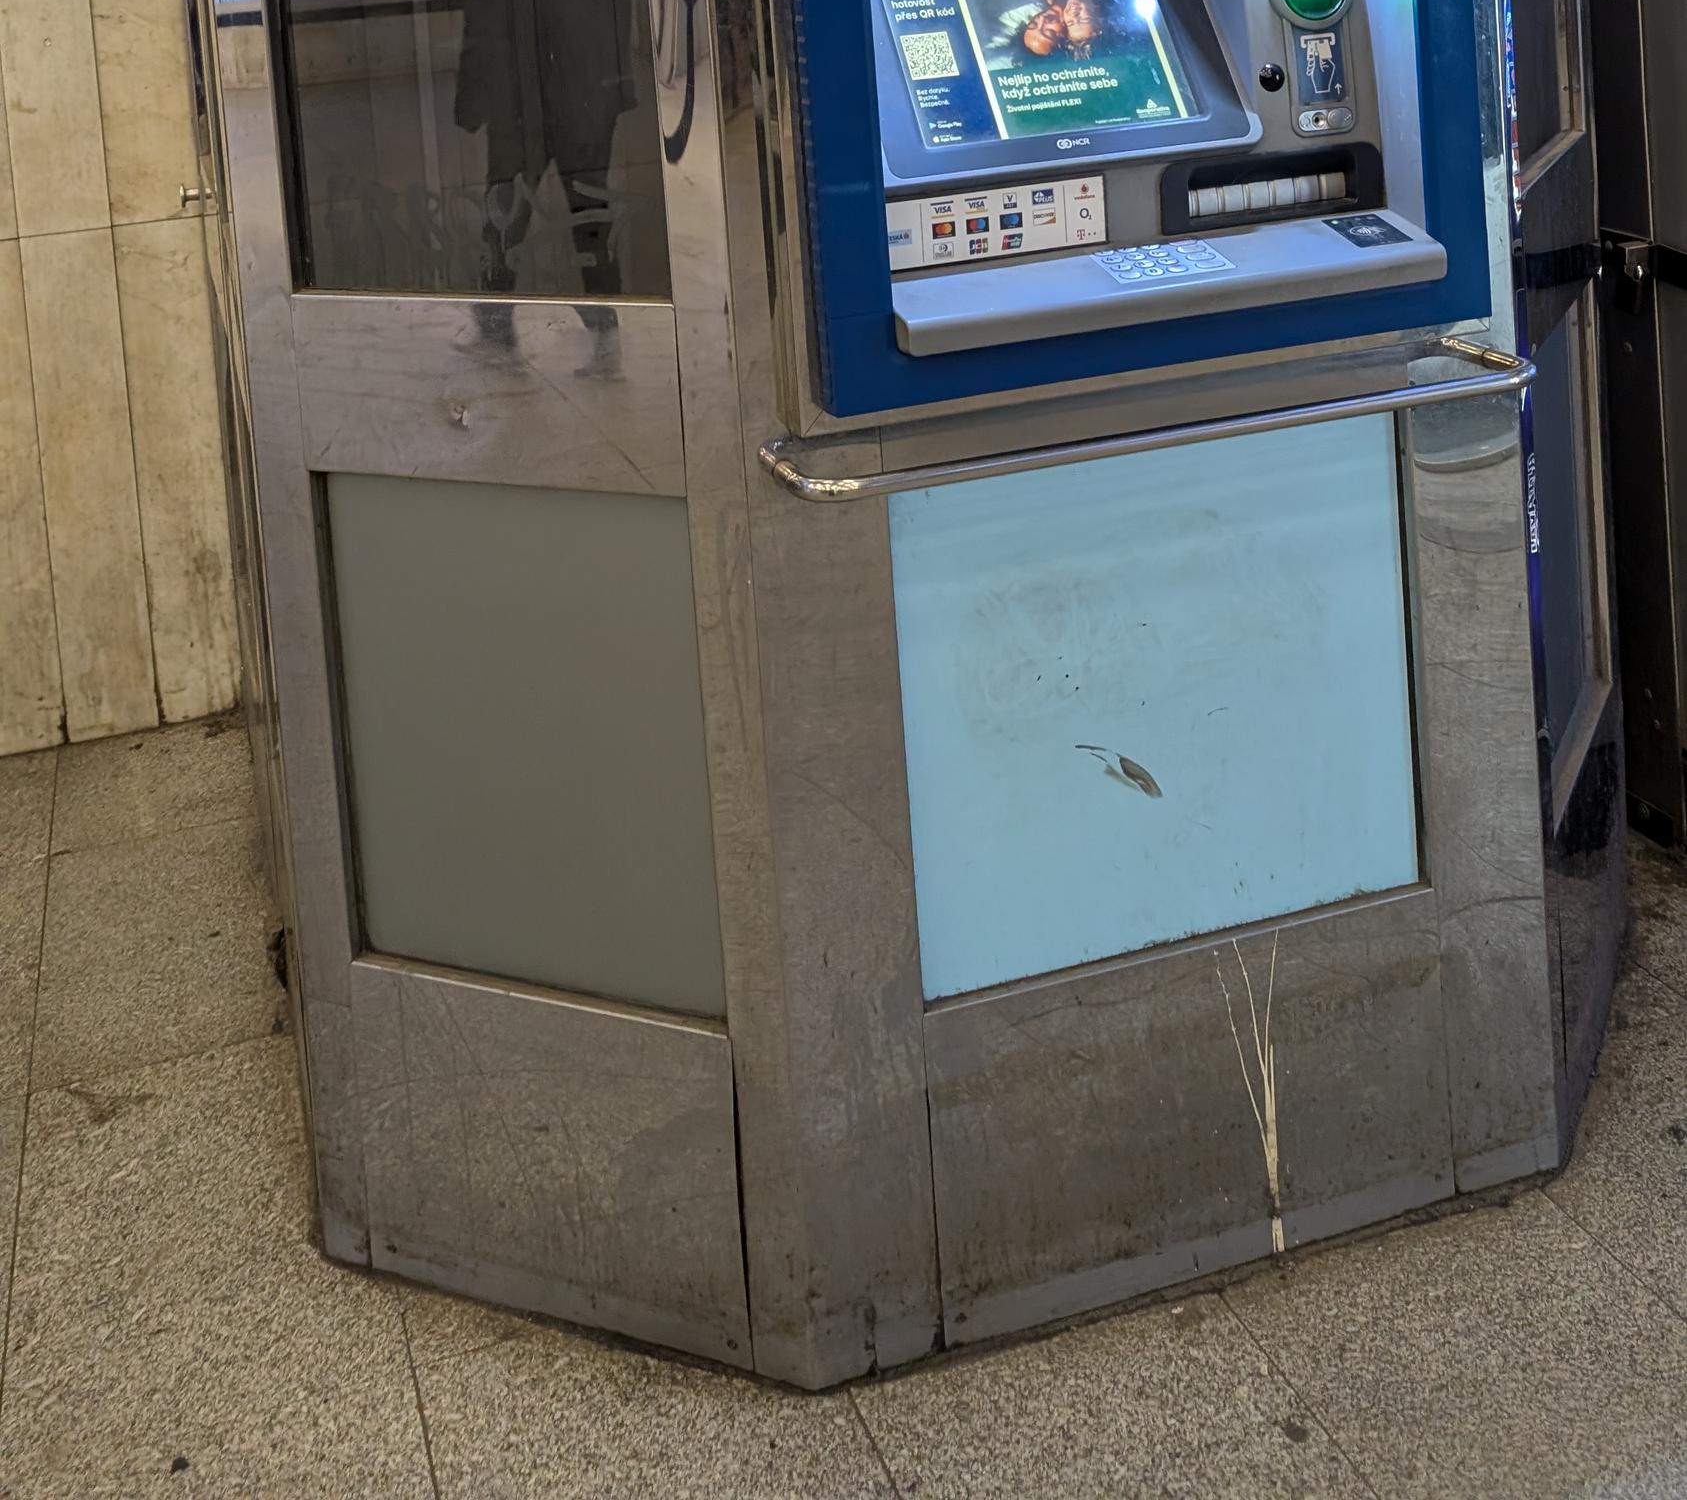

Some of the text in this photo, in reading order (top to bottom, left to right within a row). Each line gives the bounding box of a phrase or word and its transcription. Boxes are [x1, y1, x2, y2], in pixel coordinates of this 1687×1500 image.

[895, 7, 955, 22] přes QR kód
[998, 66, 1109, 87] Nejlíp ho ochráníte,
[1002, 77, 1118, 100] když ochráníte sebe
[1007, 102, 1030, 113] Životní
[1062, 98, 1082, 108] FLEXI
[1072, 137, 1090, 147] NCR
[934, 205, 952, 215] VISA
[968, 201, 985, 210] VISA
